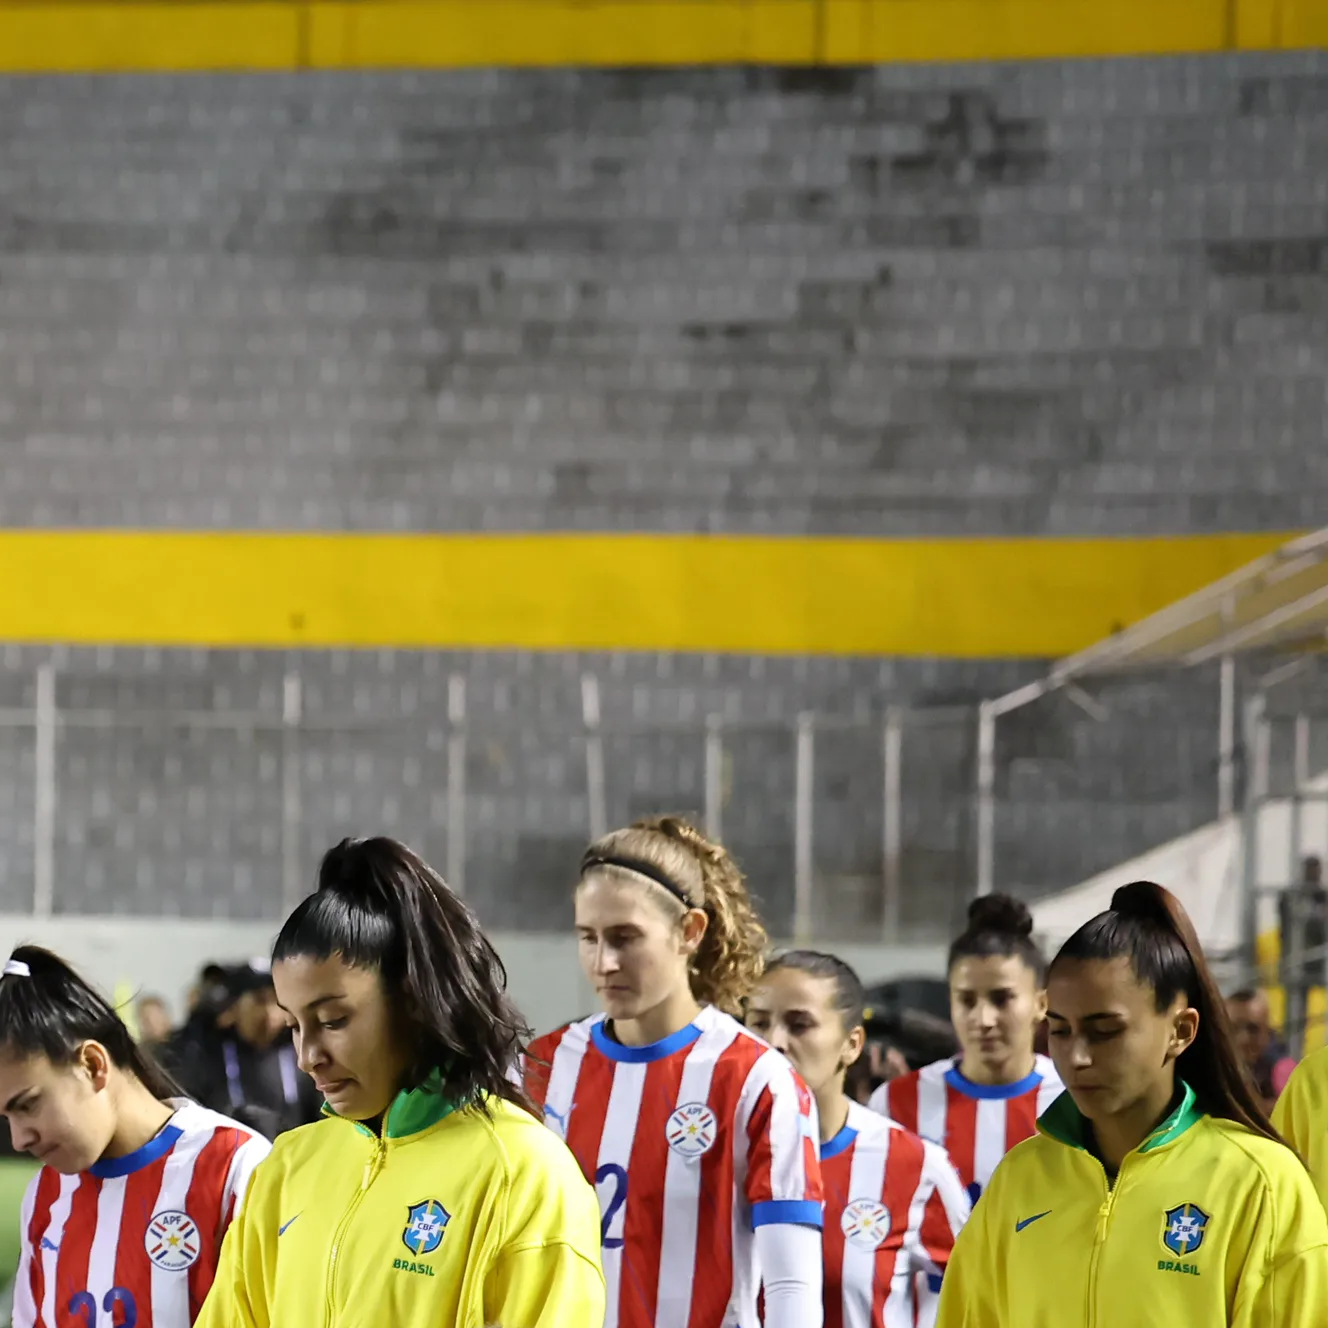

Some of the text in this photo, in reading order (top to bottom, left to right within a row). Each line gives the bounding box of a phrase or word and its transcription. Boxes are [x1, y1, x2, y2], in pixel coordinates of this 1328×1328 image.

[595, 1163, 629, 1249] 2
[162, 1214, 182, 1225] APF
[417, 1222, 435, 1231] CBF
[1177, 1225, 1193, 1233] CBF
[393, 1258, 435, 1276] BRASIL
[1158, 1260, 1200, 1276] BRASIL
